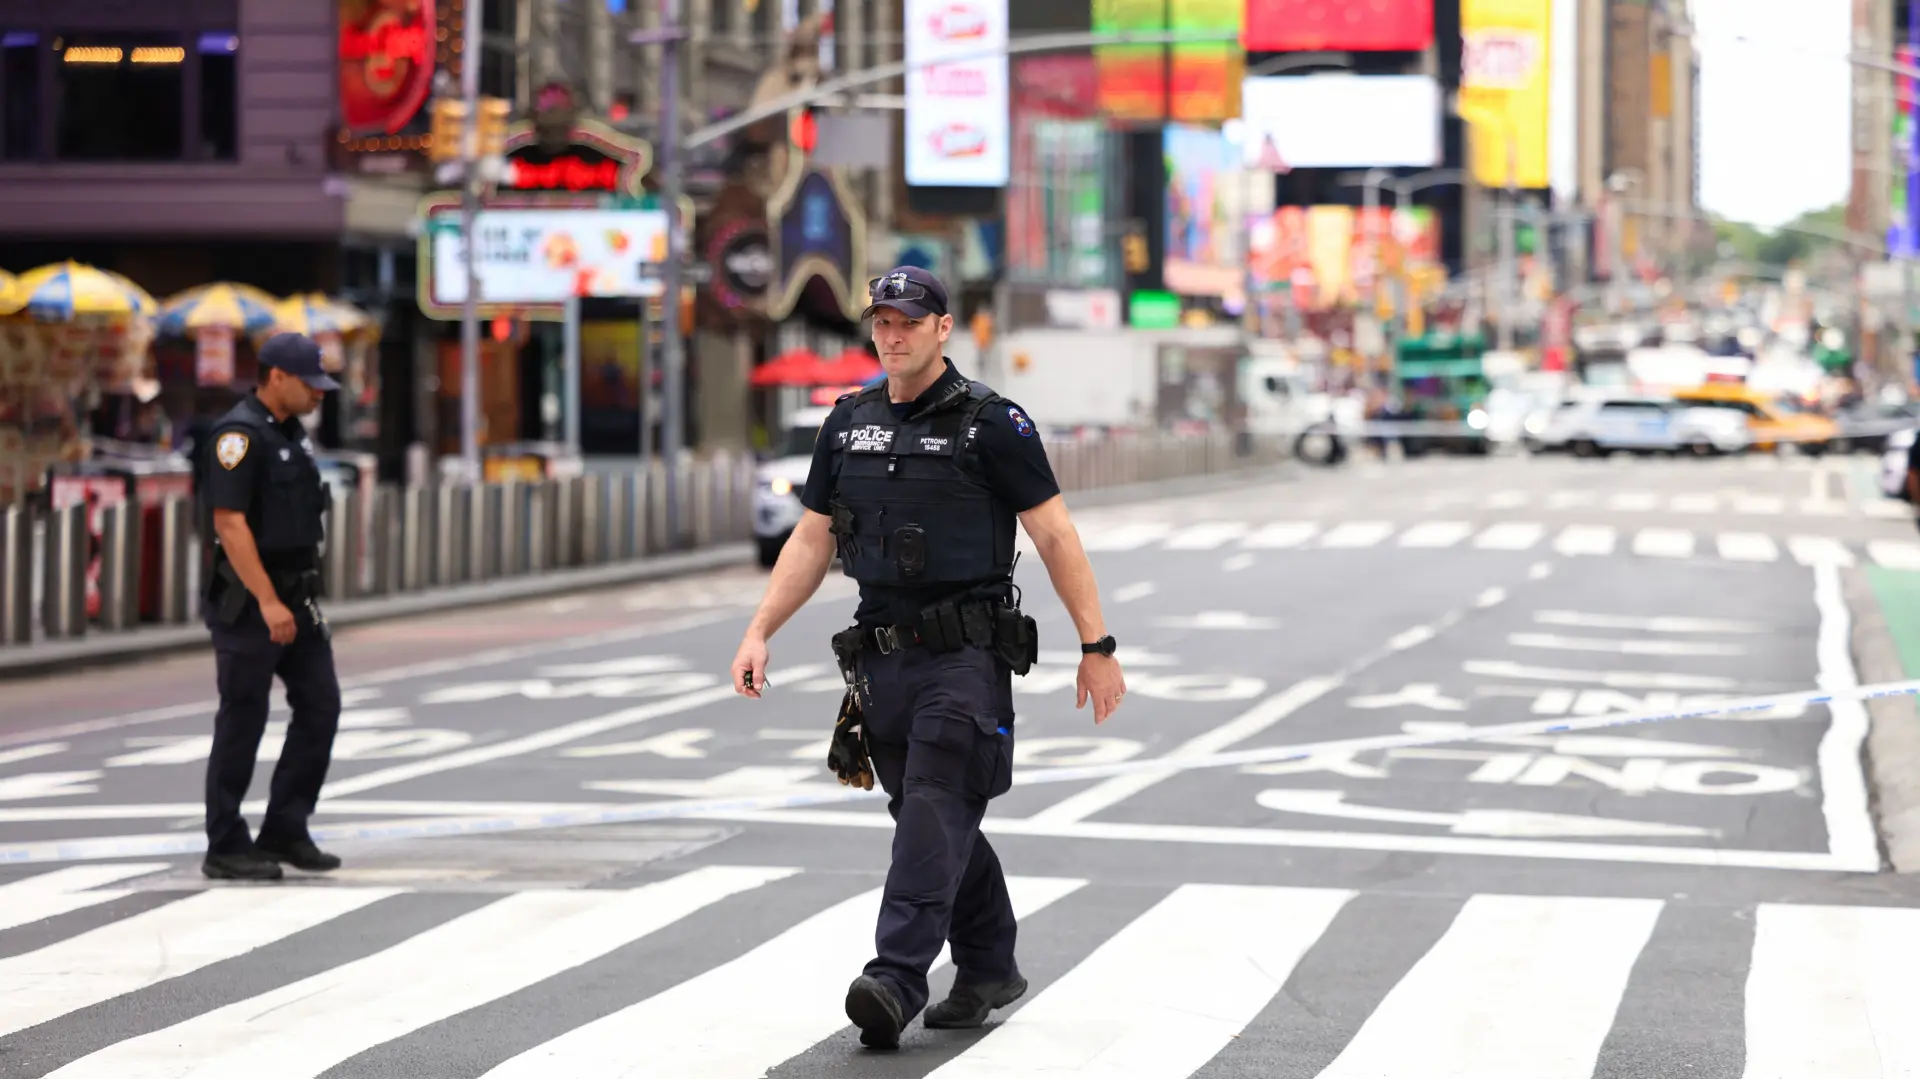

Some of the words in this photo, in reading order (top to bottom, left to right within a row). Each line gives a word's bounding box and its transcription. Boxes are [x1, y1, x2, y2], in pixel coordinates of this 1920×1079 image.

[850, 429, 893, 442] POLICE
[920, 437, 948, 445] PETRONIO
[1240, 747, 1808, 796] ONLY
